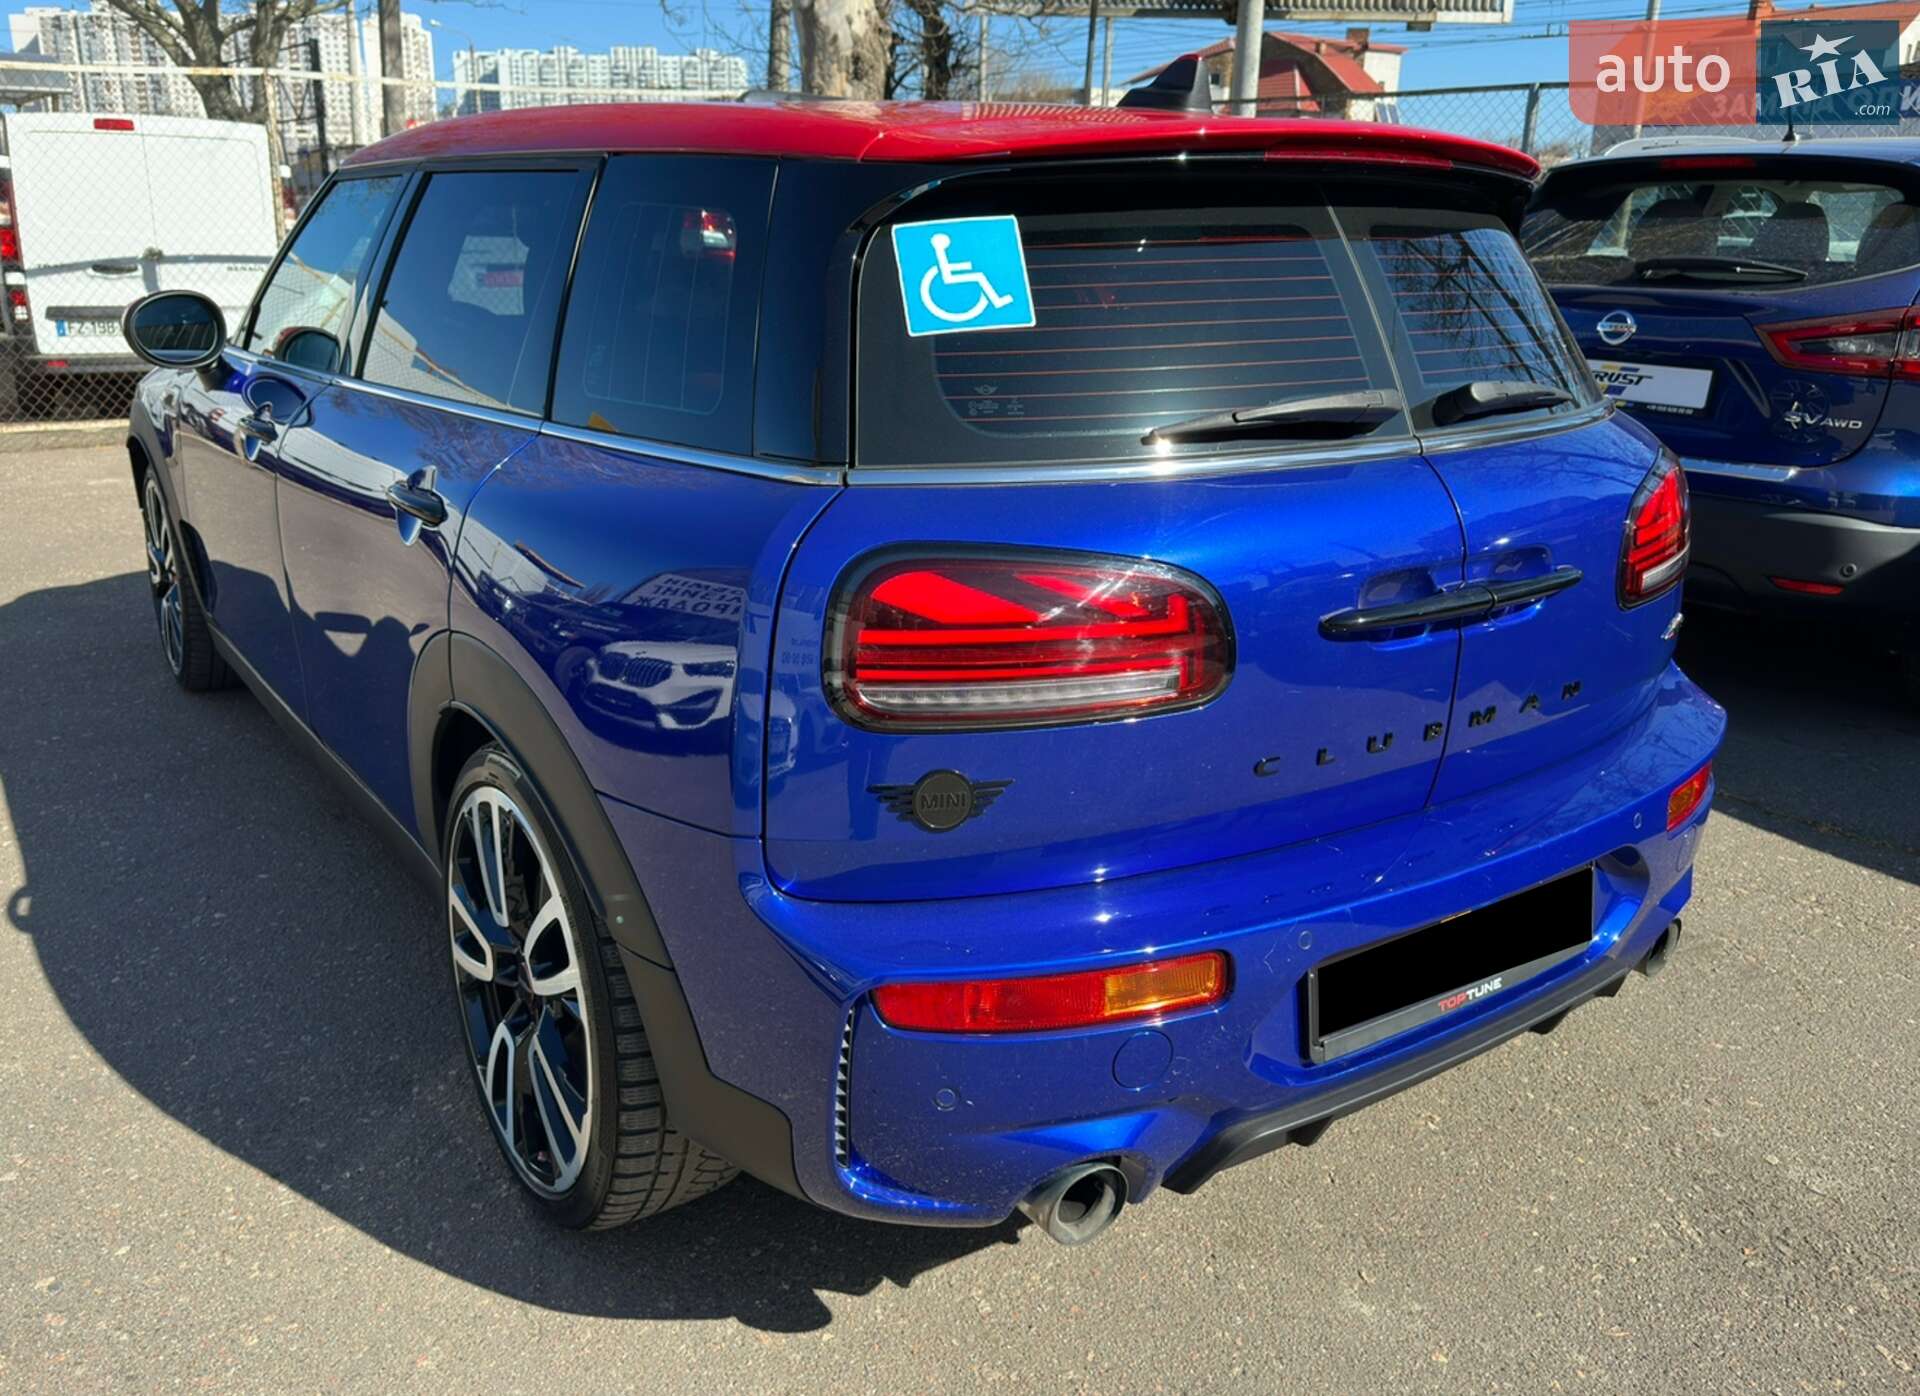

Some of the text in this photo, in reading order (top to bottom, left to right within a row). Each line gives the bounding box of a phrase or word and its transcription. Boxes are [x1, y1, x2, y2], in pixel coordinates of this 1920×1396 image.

[1820, 418, 1863, 429] AWD
[1253, 680, 1582, 778] CLUBMAN
[920, 792, 967, 810] MINI
[1438, 977, 1503, 1012] TOPTUNE
